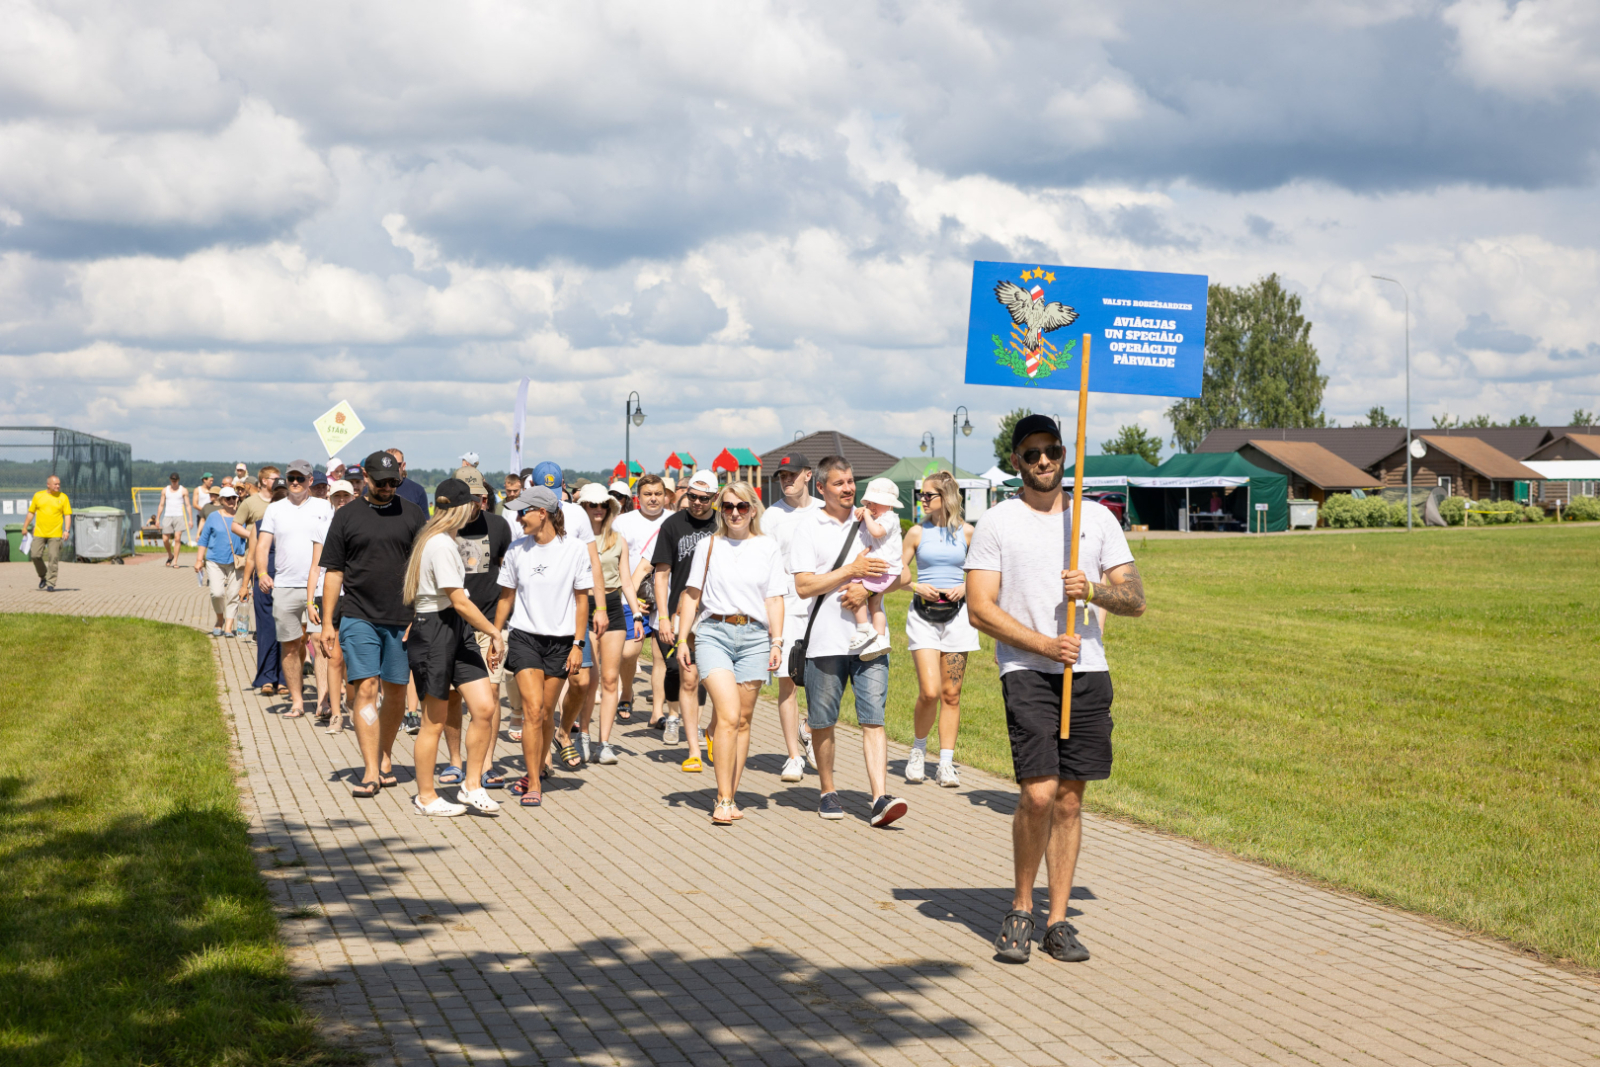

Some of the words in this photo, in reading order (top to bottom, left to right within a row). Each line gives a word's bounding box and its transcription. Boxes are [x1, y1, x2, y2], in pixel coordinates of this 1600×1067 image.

[1102, 298, 1131, 306] VALSTS
[1133, 300, 1192, 310] ROBEŽSARDZES
[1113, 316, 1177, 330] AVIĀCIJAS
[1104, 328, 1123, 339] UN
[1125, 330, 1184, 343] SPECIĀLO
[1109, 341, 1177, 355] OPERĀCIJU
[1113, 353, 1175, 368] PĀRVALDE
[327, 425, 348, 434] ŠTĀBS
